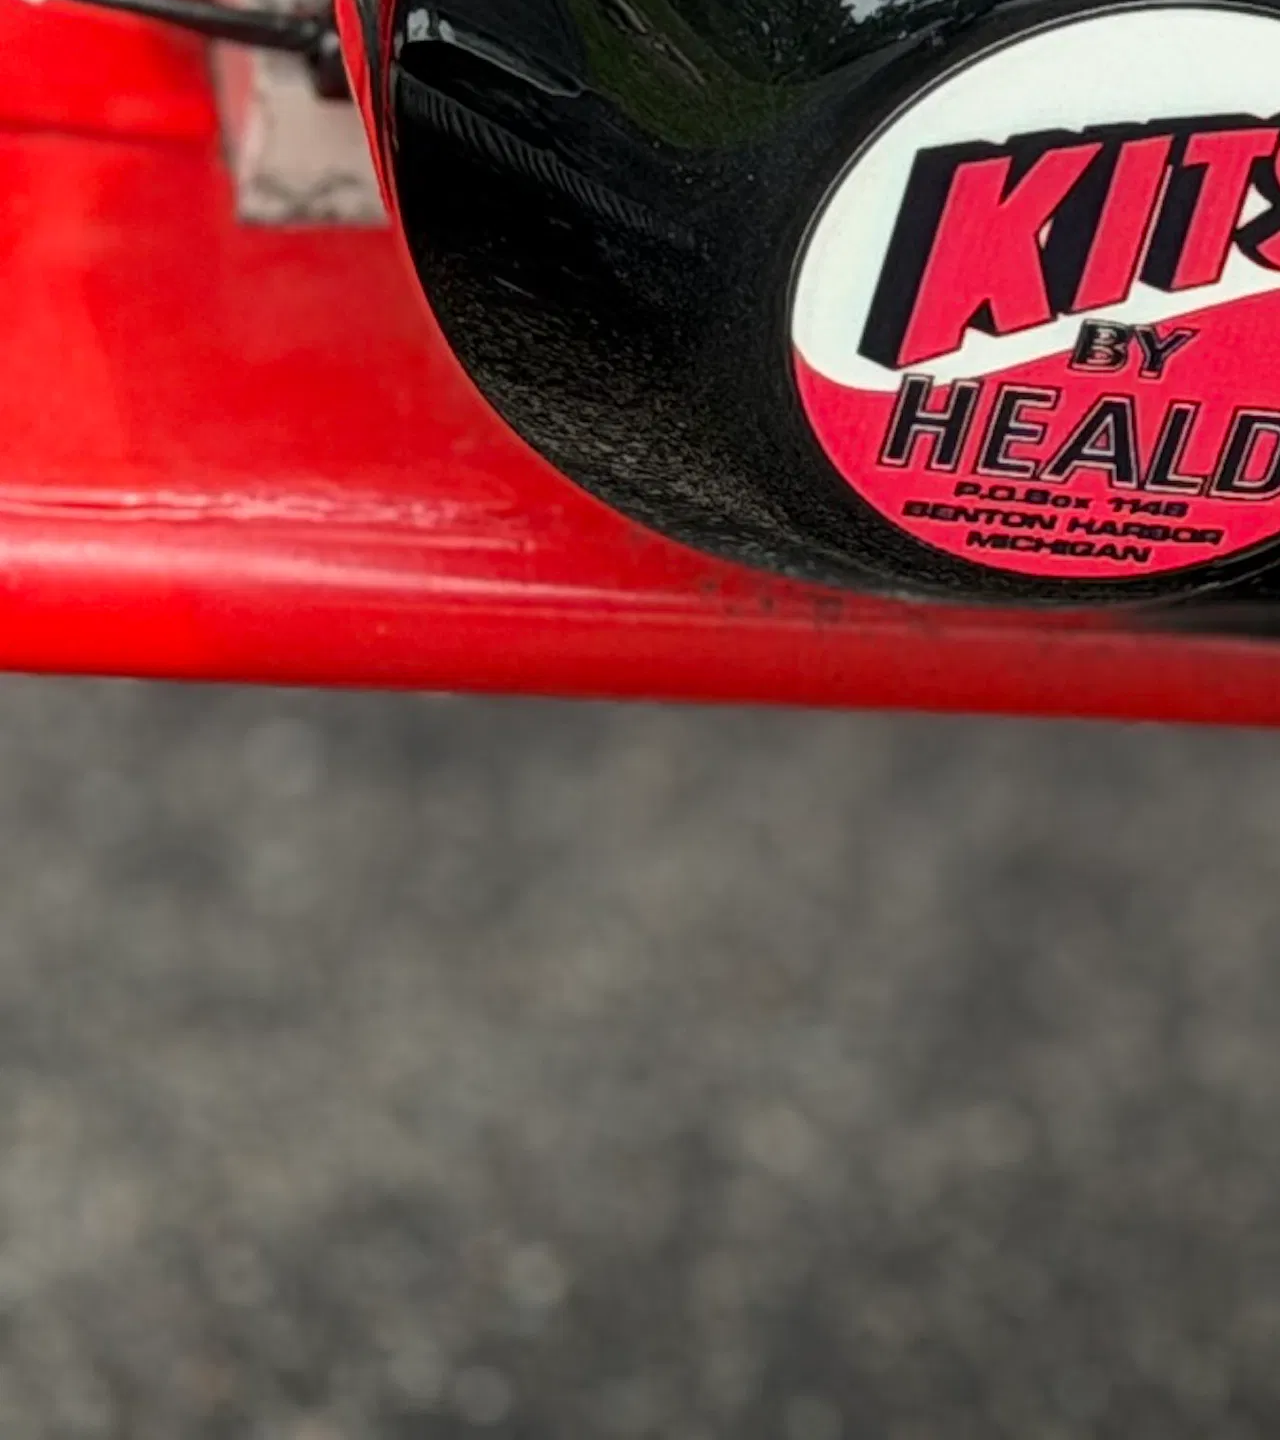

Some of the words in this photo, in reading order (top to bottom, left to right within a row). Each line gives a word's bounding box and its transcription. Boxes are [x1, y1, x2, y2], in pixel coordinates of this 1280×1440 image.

[1067, 319, 1195, 379] BY
[901, 499, 1057, 530] BENTON
[1067, 516, 1225, 545] HARBOR
[966, 531, 1153, 563] MICHIGAN
